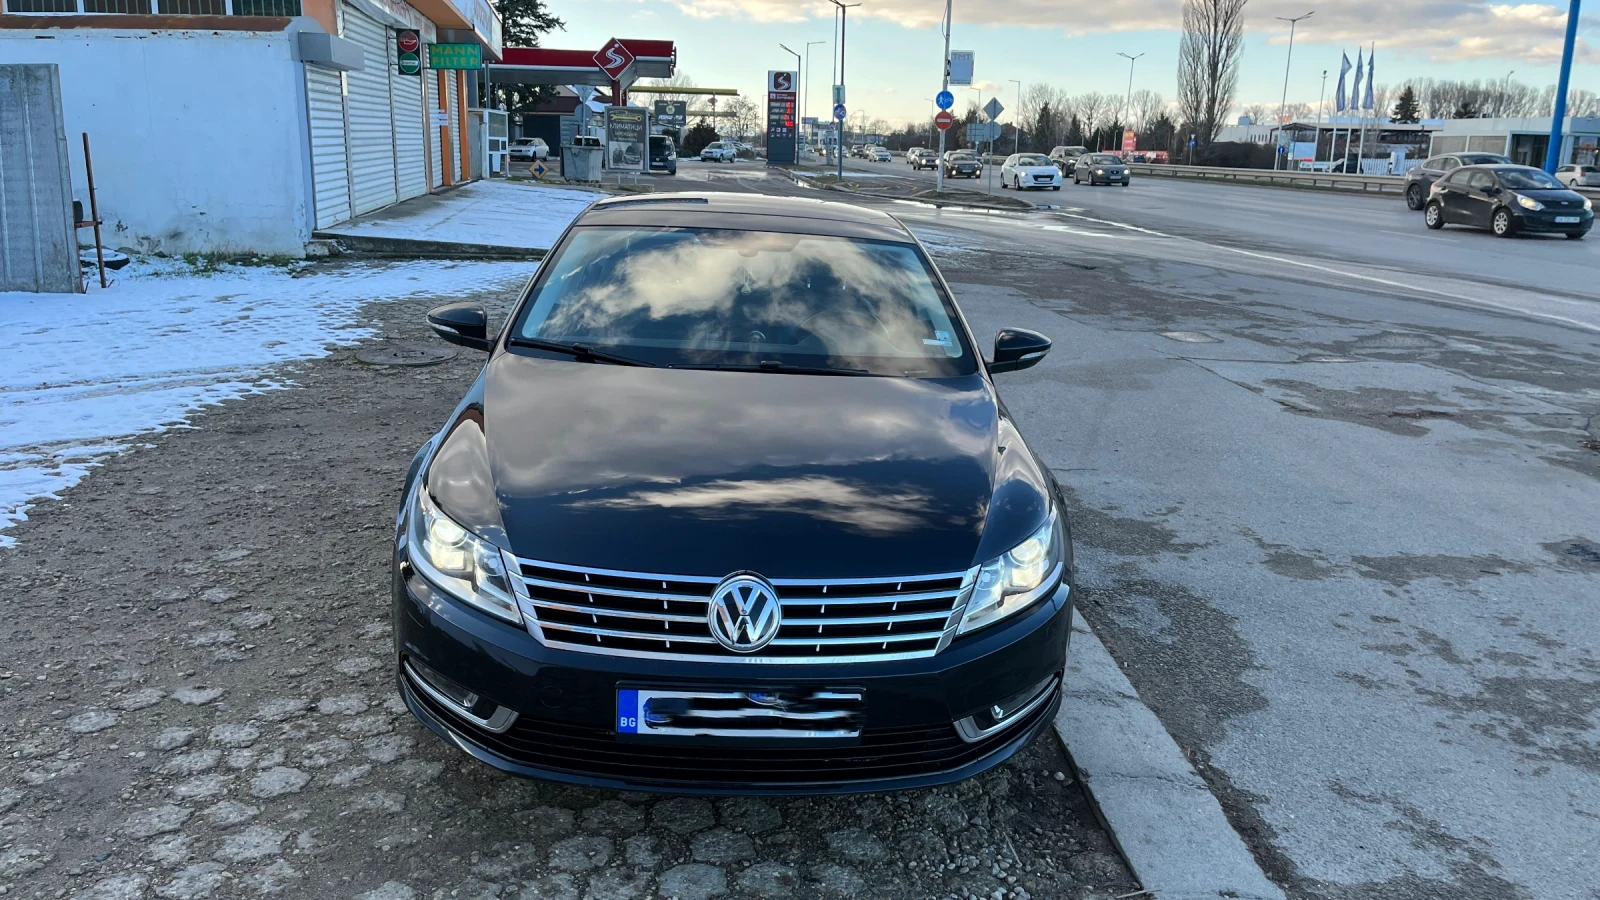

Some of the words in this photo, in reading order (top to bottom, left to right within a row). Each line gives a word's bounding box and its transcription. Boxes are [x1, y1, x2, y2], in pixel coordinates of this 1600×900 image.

[431, 45, 478, 55] MANN
[432, 56, 479, 67] FILTER
[620, 716, 636, 727] BG
